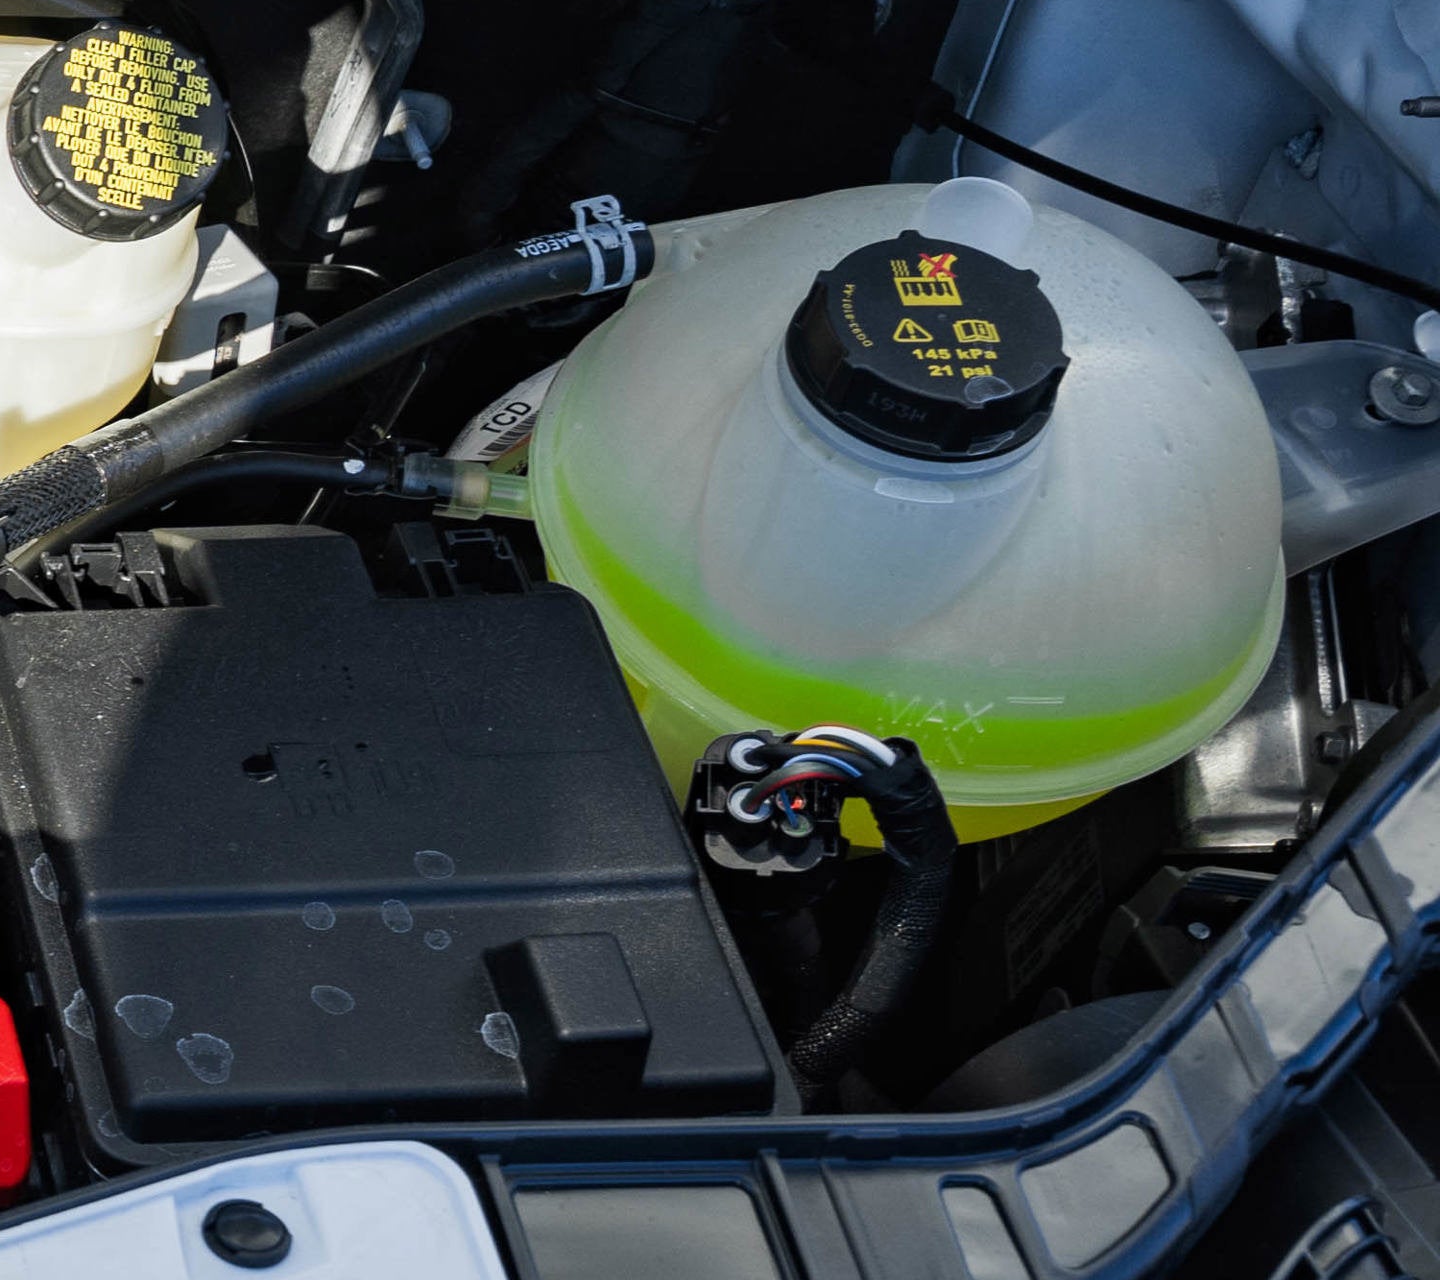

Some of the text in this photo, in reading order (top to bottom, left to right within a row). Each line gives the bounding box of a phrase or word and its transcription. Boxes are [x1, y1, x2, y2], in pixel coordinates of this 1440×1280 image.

[87, 39, 196, 74] CLEAN FILLER CAP
[119, 30, 174, 55] WARNING:
[63, 62, 211, 108] ONLY DOT 4 FLUID FROM
[70, 49, 208, 92] BEFORE REMOVING. USE
[71, 78, 81, 93] A
[85, 81, 129, 102] SEALED
[61, 106, 202, 148] NETTOYER LE BOUCHON
[86, 99, 181, 130] AVERTISSEMENT:
[42, 117, 82, 138] AVANT
[85, 126, 103, 142] DE
[106, 130, 122, 146] LE
[55, 134, 200, 178] PLOYER QUE DU LIQUIDE
[71, 152, 181, 188] DOT 4 PROVENANT
[108, 174, 174, 201] CONTENANT
[911, 348, 998, 361] 145 kPa
[928, 365, 994, 379] 21 psi
